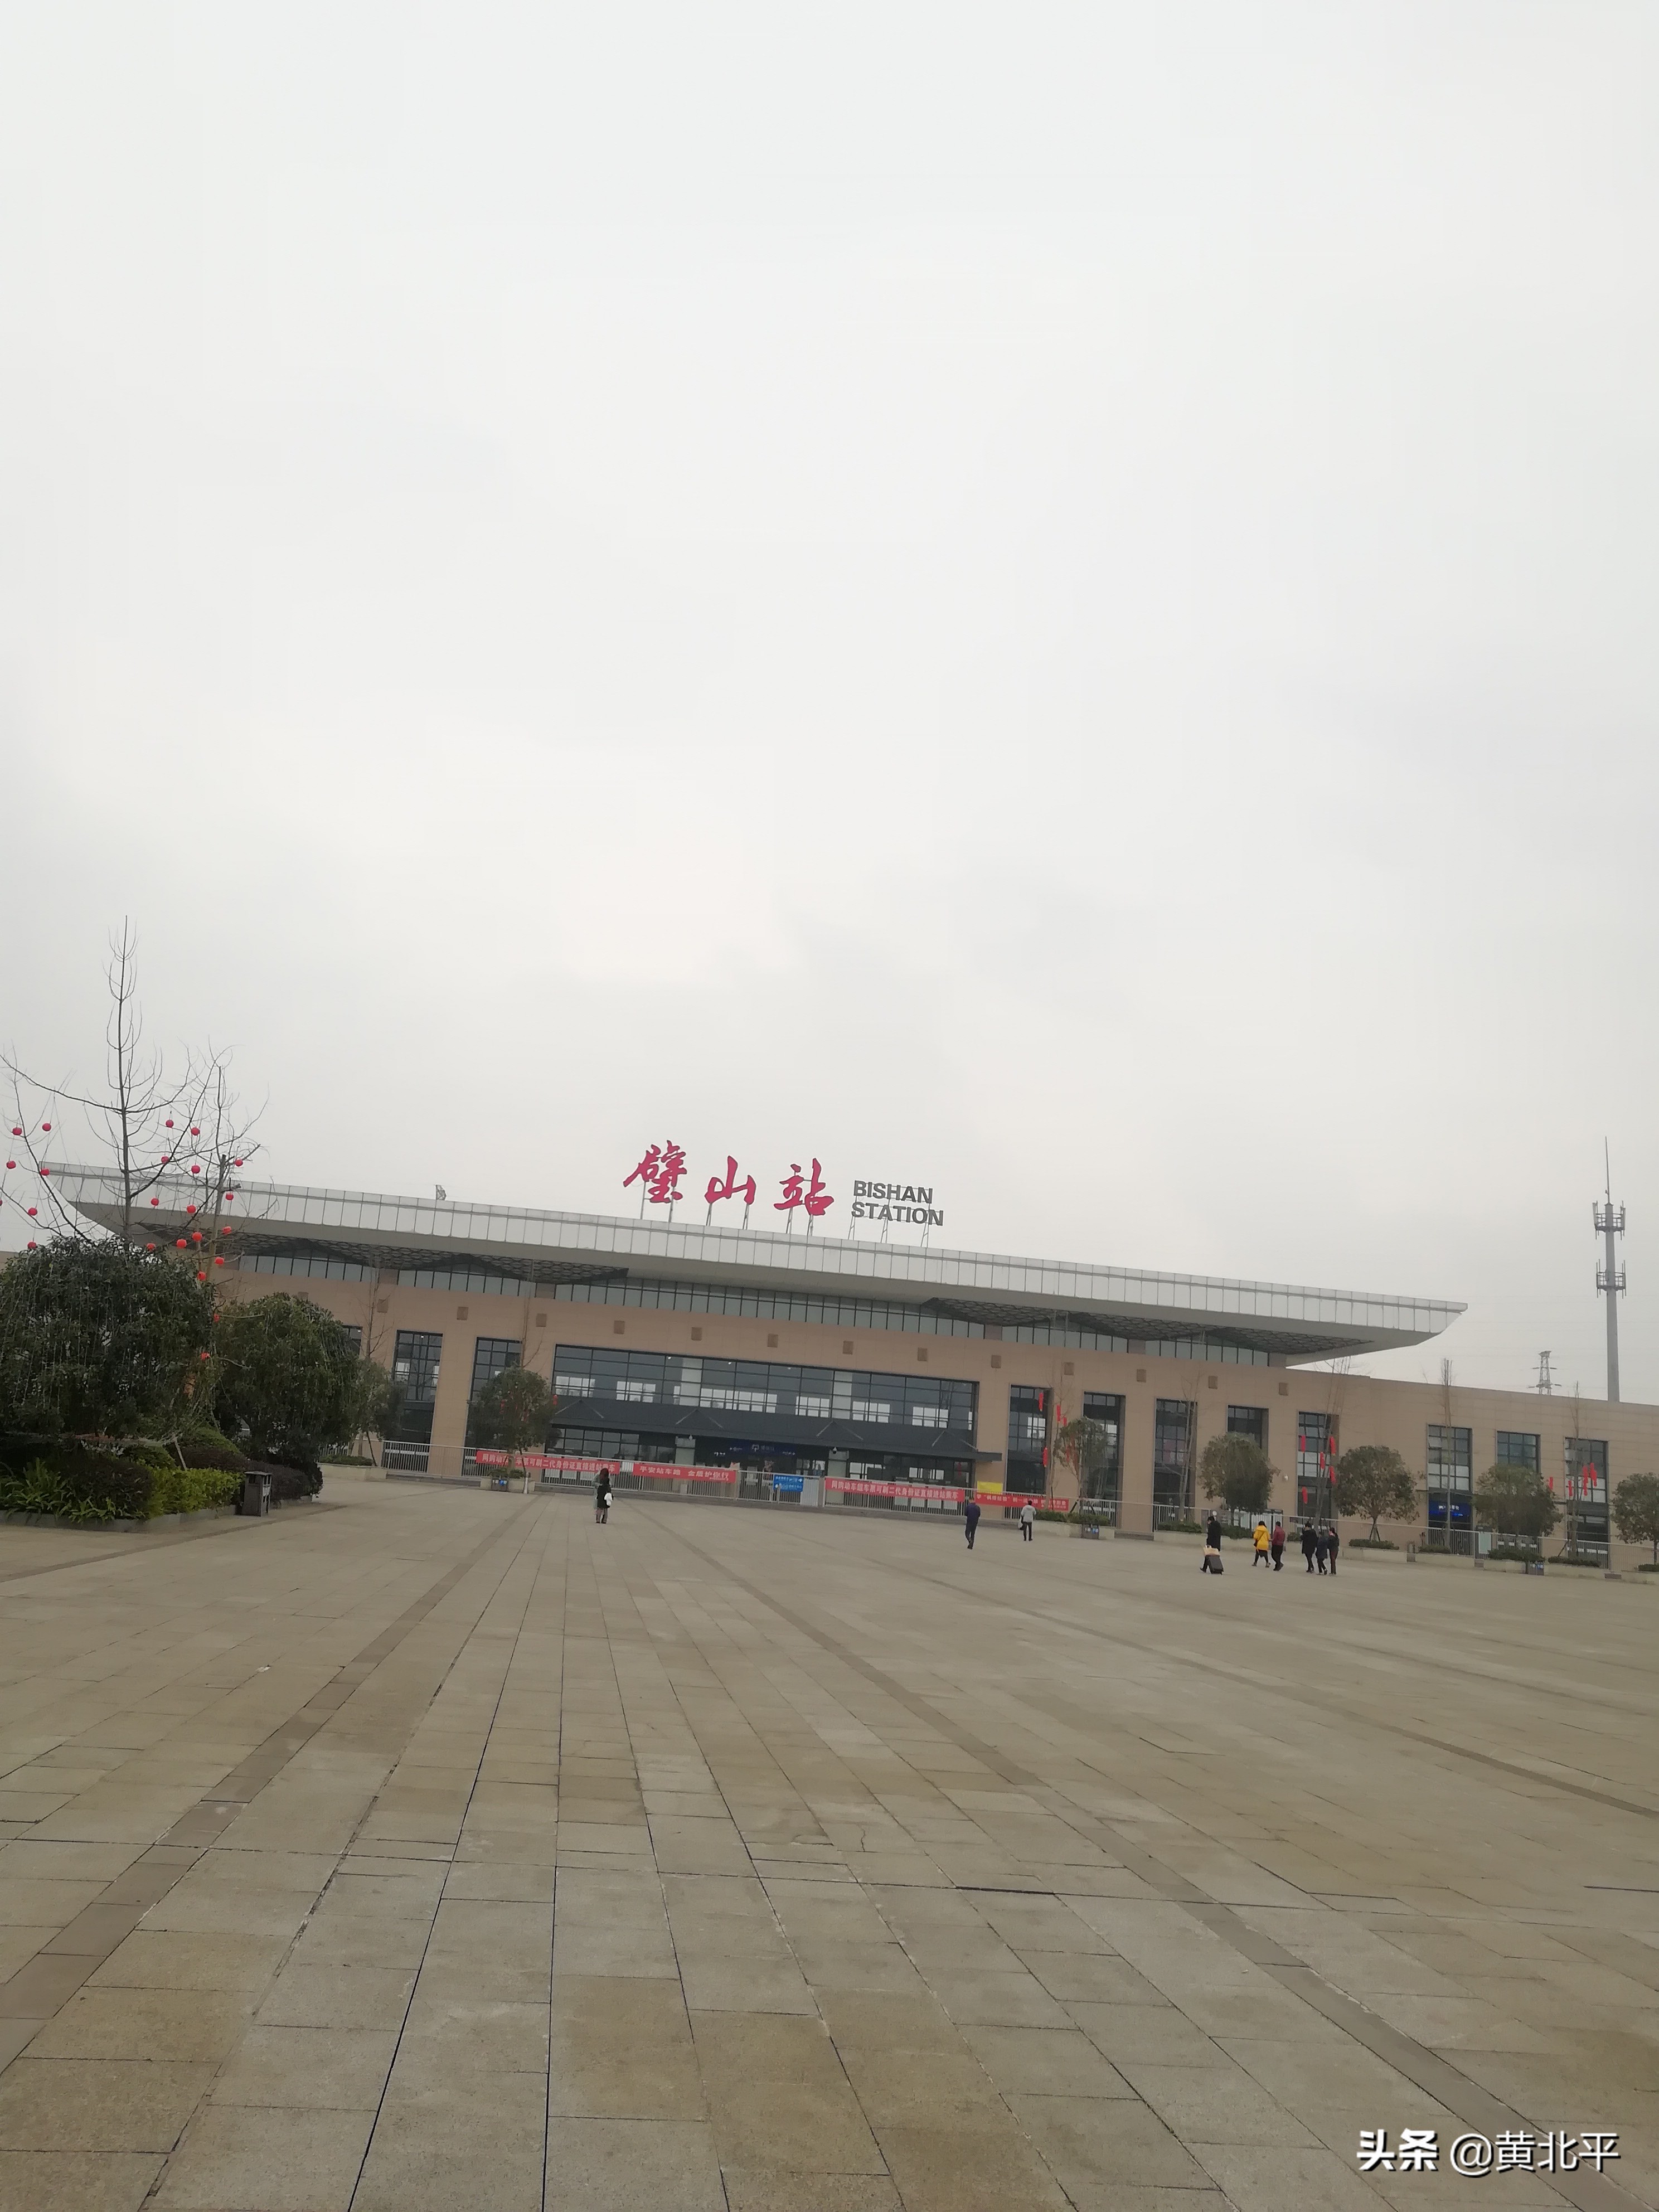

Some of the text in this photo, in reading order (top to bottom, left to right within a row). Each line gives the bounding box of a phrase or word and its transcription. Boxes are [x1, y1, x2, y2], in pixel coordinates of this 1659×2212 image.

[623, 1140, 834, 1215] 璧山站
[853, 1180, 933, 1204] BISHAN
[851, 1201, 943, 1226] STATION
